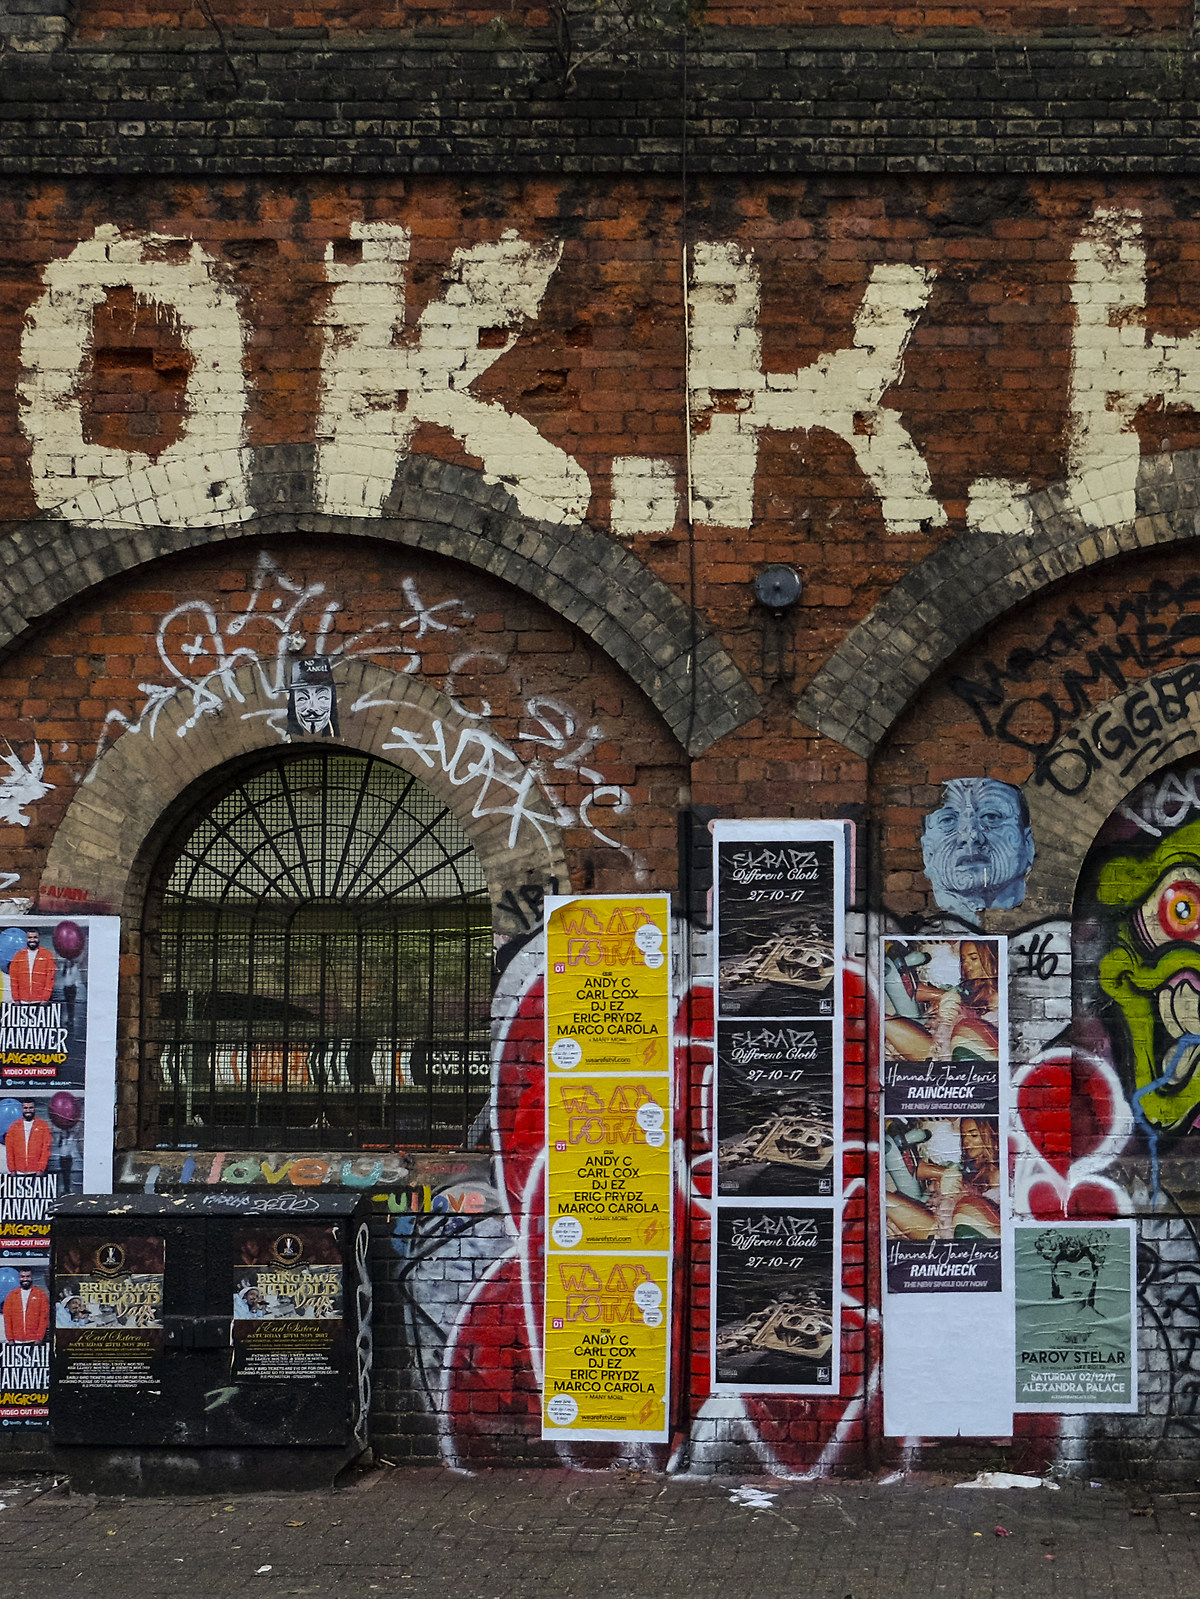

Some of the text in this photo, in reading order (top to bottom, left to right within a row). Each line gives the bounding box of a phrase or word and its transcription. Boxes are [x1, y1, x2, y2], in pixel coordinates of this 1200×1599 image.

[732, 867, 819, 885] Different Cloth
[747, 890, 805, 902] 27-10-17
[584, 977, 631, 988] ANDY C
[576, 989, 639, 1000] CARL COX
[591, 1001, 624, 1011] DJ EZ
[0, 1002, 62, 1028] HUSSAIN
[573, 1012, 642, 1023] ERIC PRYDZ
[557, 1024, 659, 1035] MARCO CAROLA
[731, 1047, 818, 1064] Different Cloth
[746, 1069, 804, 1081] 27-10-17
[886, 1061, 997, 1087] Hannah Jane Lewis
[907, 1086, 976, 1099] RAINCHECK
[585, 1156, 632, 1166] ANDY C
[577, 1168, 640, 1179] CARL COX
[592, 1180, 626, 1190] DJ EZ
[574, 1191, 643, 1202] ERIC PRYDZ
[558, 1203, 660, 1213] MARCO CAROLA
[731, 1233, 819, 1251] Different Cloth
[887, 1239, 999, 1266] Hannah Jane Lewis
[745, 1256, 804, 1268] 27-10-17
[909, 1264, 978, 1277] RAINCHECK
[257, 1273, 339, 1283] BRING BACK
[79, 1282, 160, 1292] BRING BACK
[258, 1283, 339, 1296] THE OLD
[80, 1292, 161, 1305] THE OLD
[582, 1335, 629, 1345] ANDY C
[574, 1346, 637, 1357] CARL COX
[1021, 1351, 1125, 1363] PAROV STELAR
[588, 1358, 622, 1369] DJ EZ
[570, 1370, 640, 1381] ERIC PRYDZ
[1031, 1372, 1117, 1383] SATURDAY 02/12/17
[554, 1381, 656, 1393] MARCO CAROLA
[1022, 1383, 1125, 1392] ALEXANDRA PALACE
